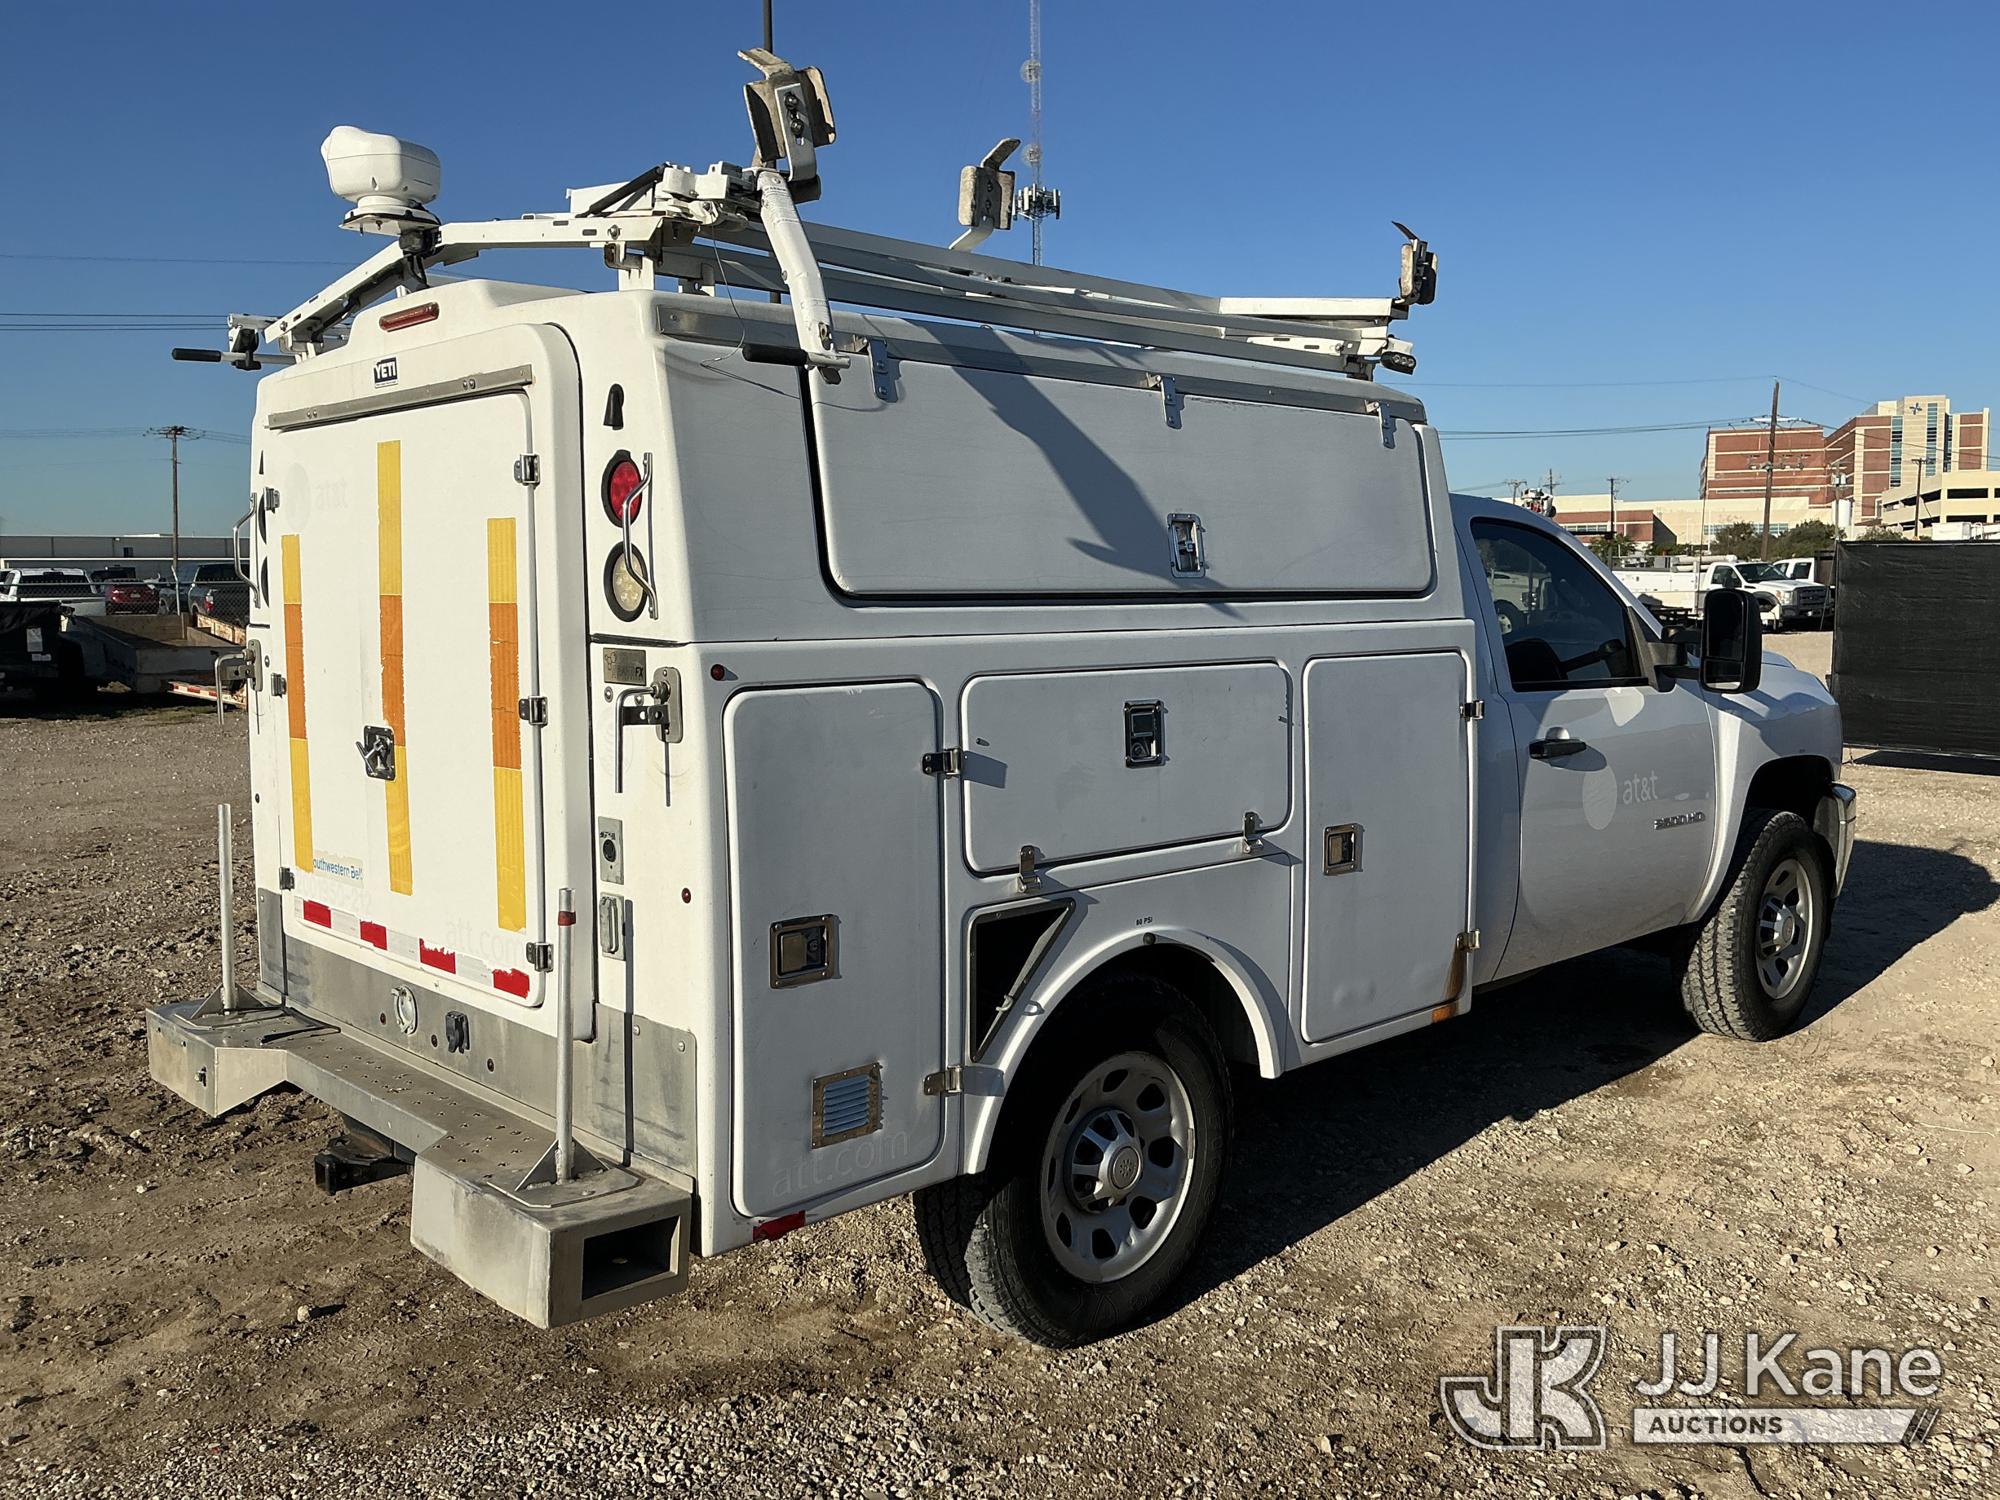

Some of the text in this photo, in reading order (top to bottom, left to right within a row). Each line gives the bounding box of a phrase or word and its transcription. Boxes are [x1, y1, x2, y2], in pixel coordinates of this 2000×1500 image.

[375, 361, 397, 380] YETI
[1622, 769, 1659, 806] at&t
[312, 857, 350, 876] outhwestern
[771, 1131, 911, 1197] att.com
